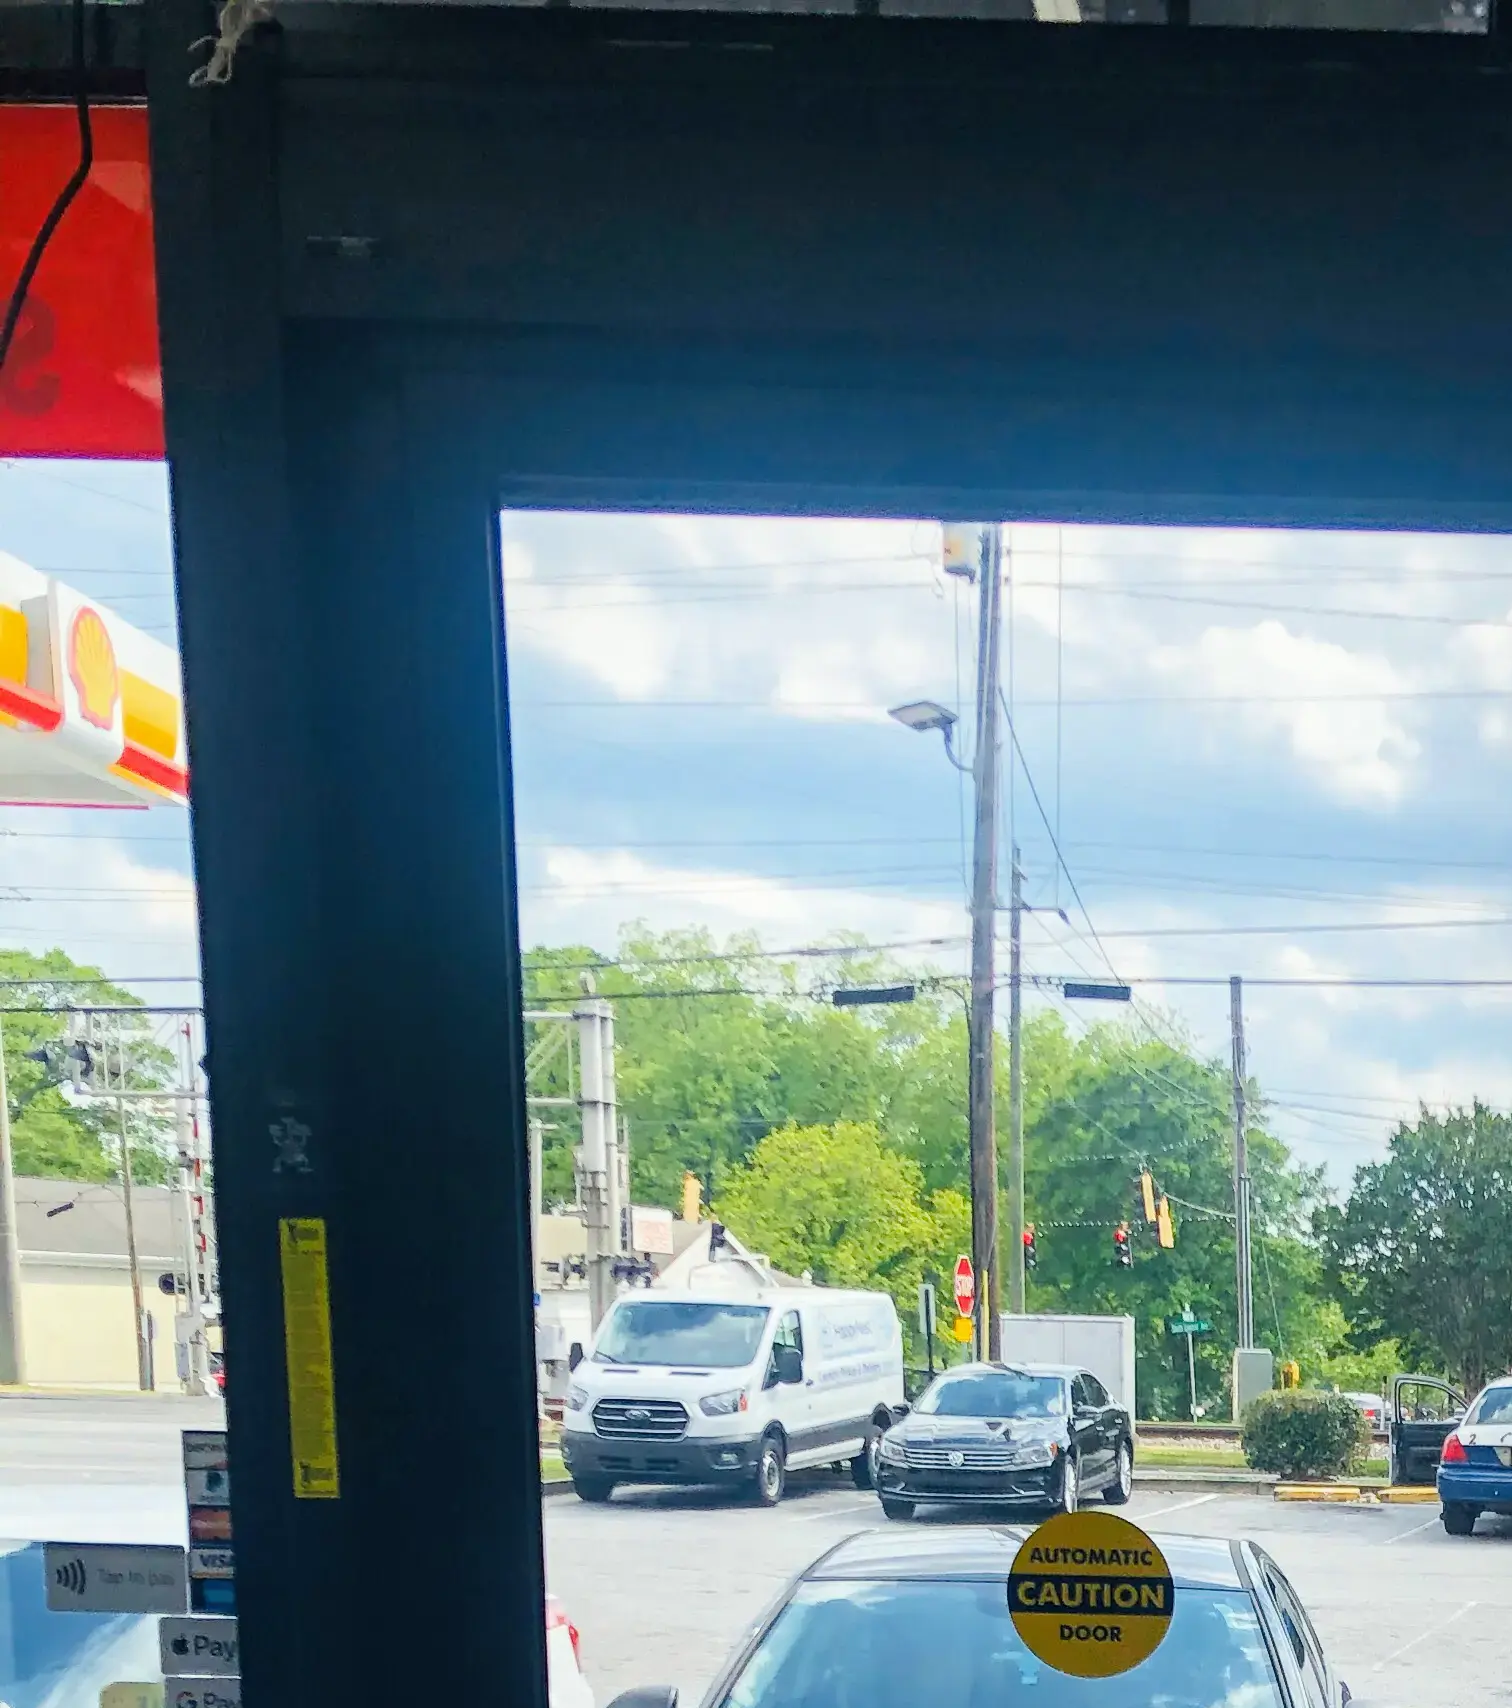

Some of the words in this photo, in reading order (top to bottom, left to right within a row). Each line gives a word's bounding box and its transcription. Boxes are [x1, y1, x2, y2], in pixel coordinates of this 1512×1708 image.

[1030, 1547, 1153, 1566] AUTOMATIC
[1016, 1580, 1165, 1609] CAUTION
[1059, 1624, 1122, 1642] DOOR
[193, 1634, 236, 1662] Pay
